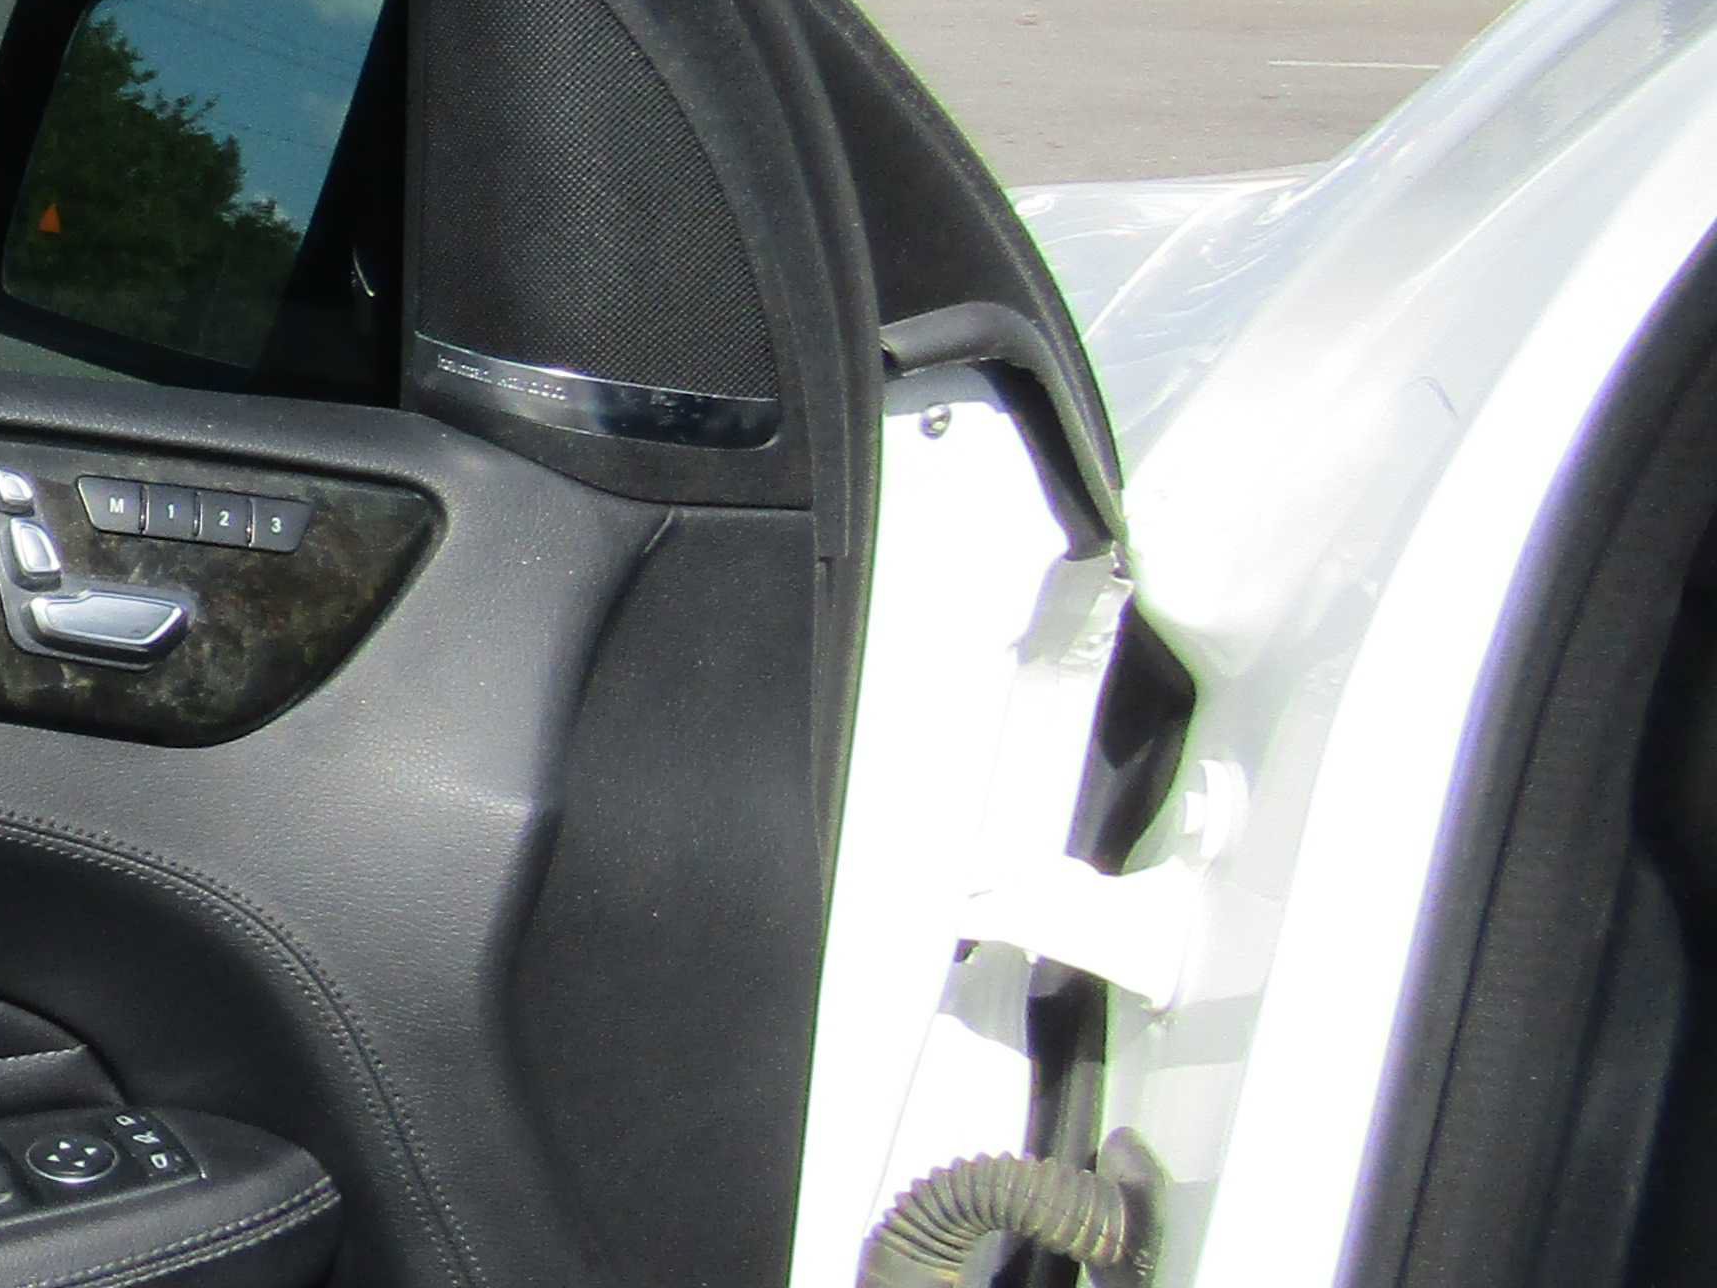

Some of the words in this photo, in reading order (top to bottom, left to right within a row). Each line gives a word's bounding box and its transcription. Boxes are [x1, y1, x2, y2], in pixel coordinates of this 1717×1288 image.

[109, 497, 125, 514] M
[167, 504, 175, 519] 1
[218, 510, 230, 527] 2
[270, 517, 282, 533] 3
